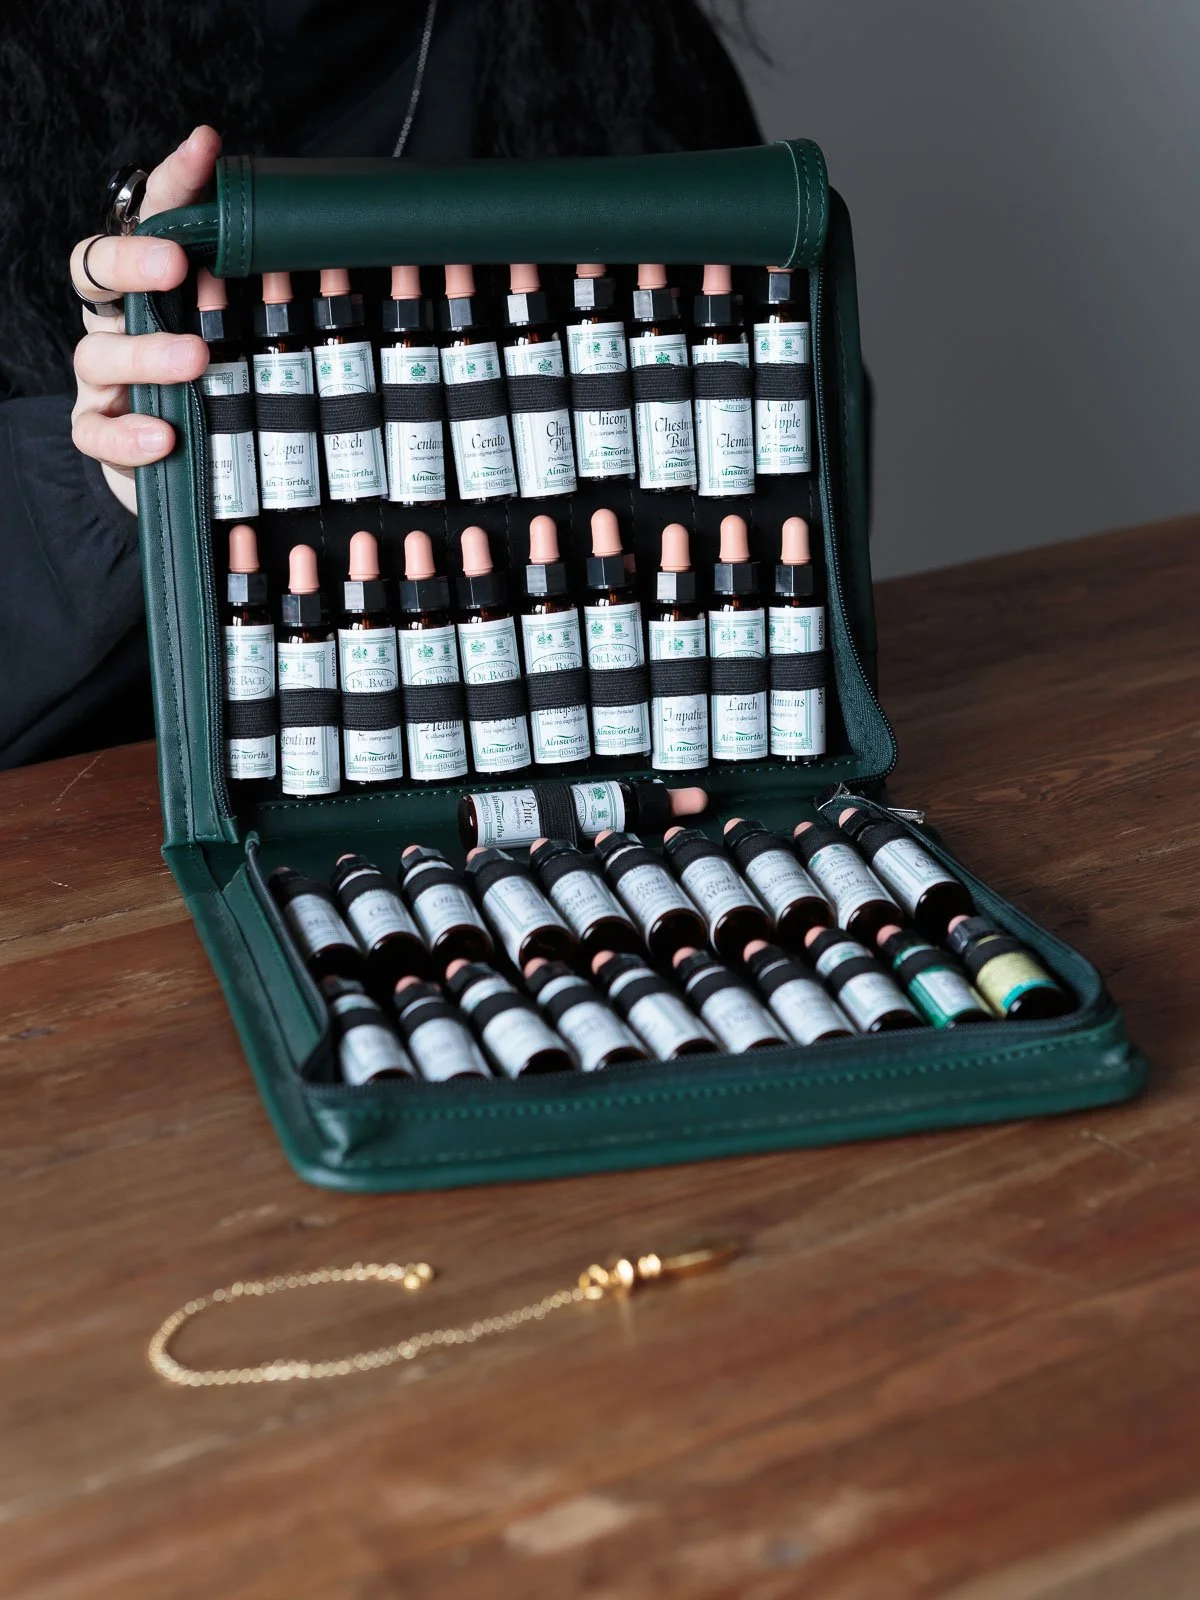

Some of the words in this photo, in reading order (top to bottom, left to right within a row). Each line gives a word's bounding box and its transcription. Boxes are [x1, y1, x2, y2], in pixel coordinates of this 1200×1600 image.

[588, 411, 628, 429] Chicory
[471, 433, 506, 450] Cerato
[666, 432, 690, 448] Bud
[726, 696, 758, 712] Larch
[481, 742, 525, 755] Ainsworths
[353, 752, 398, 763] Ainsworths
[490, 795, 505, 838] Ainsworths
[520, 796, 537, 826] Pine
